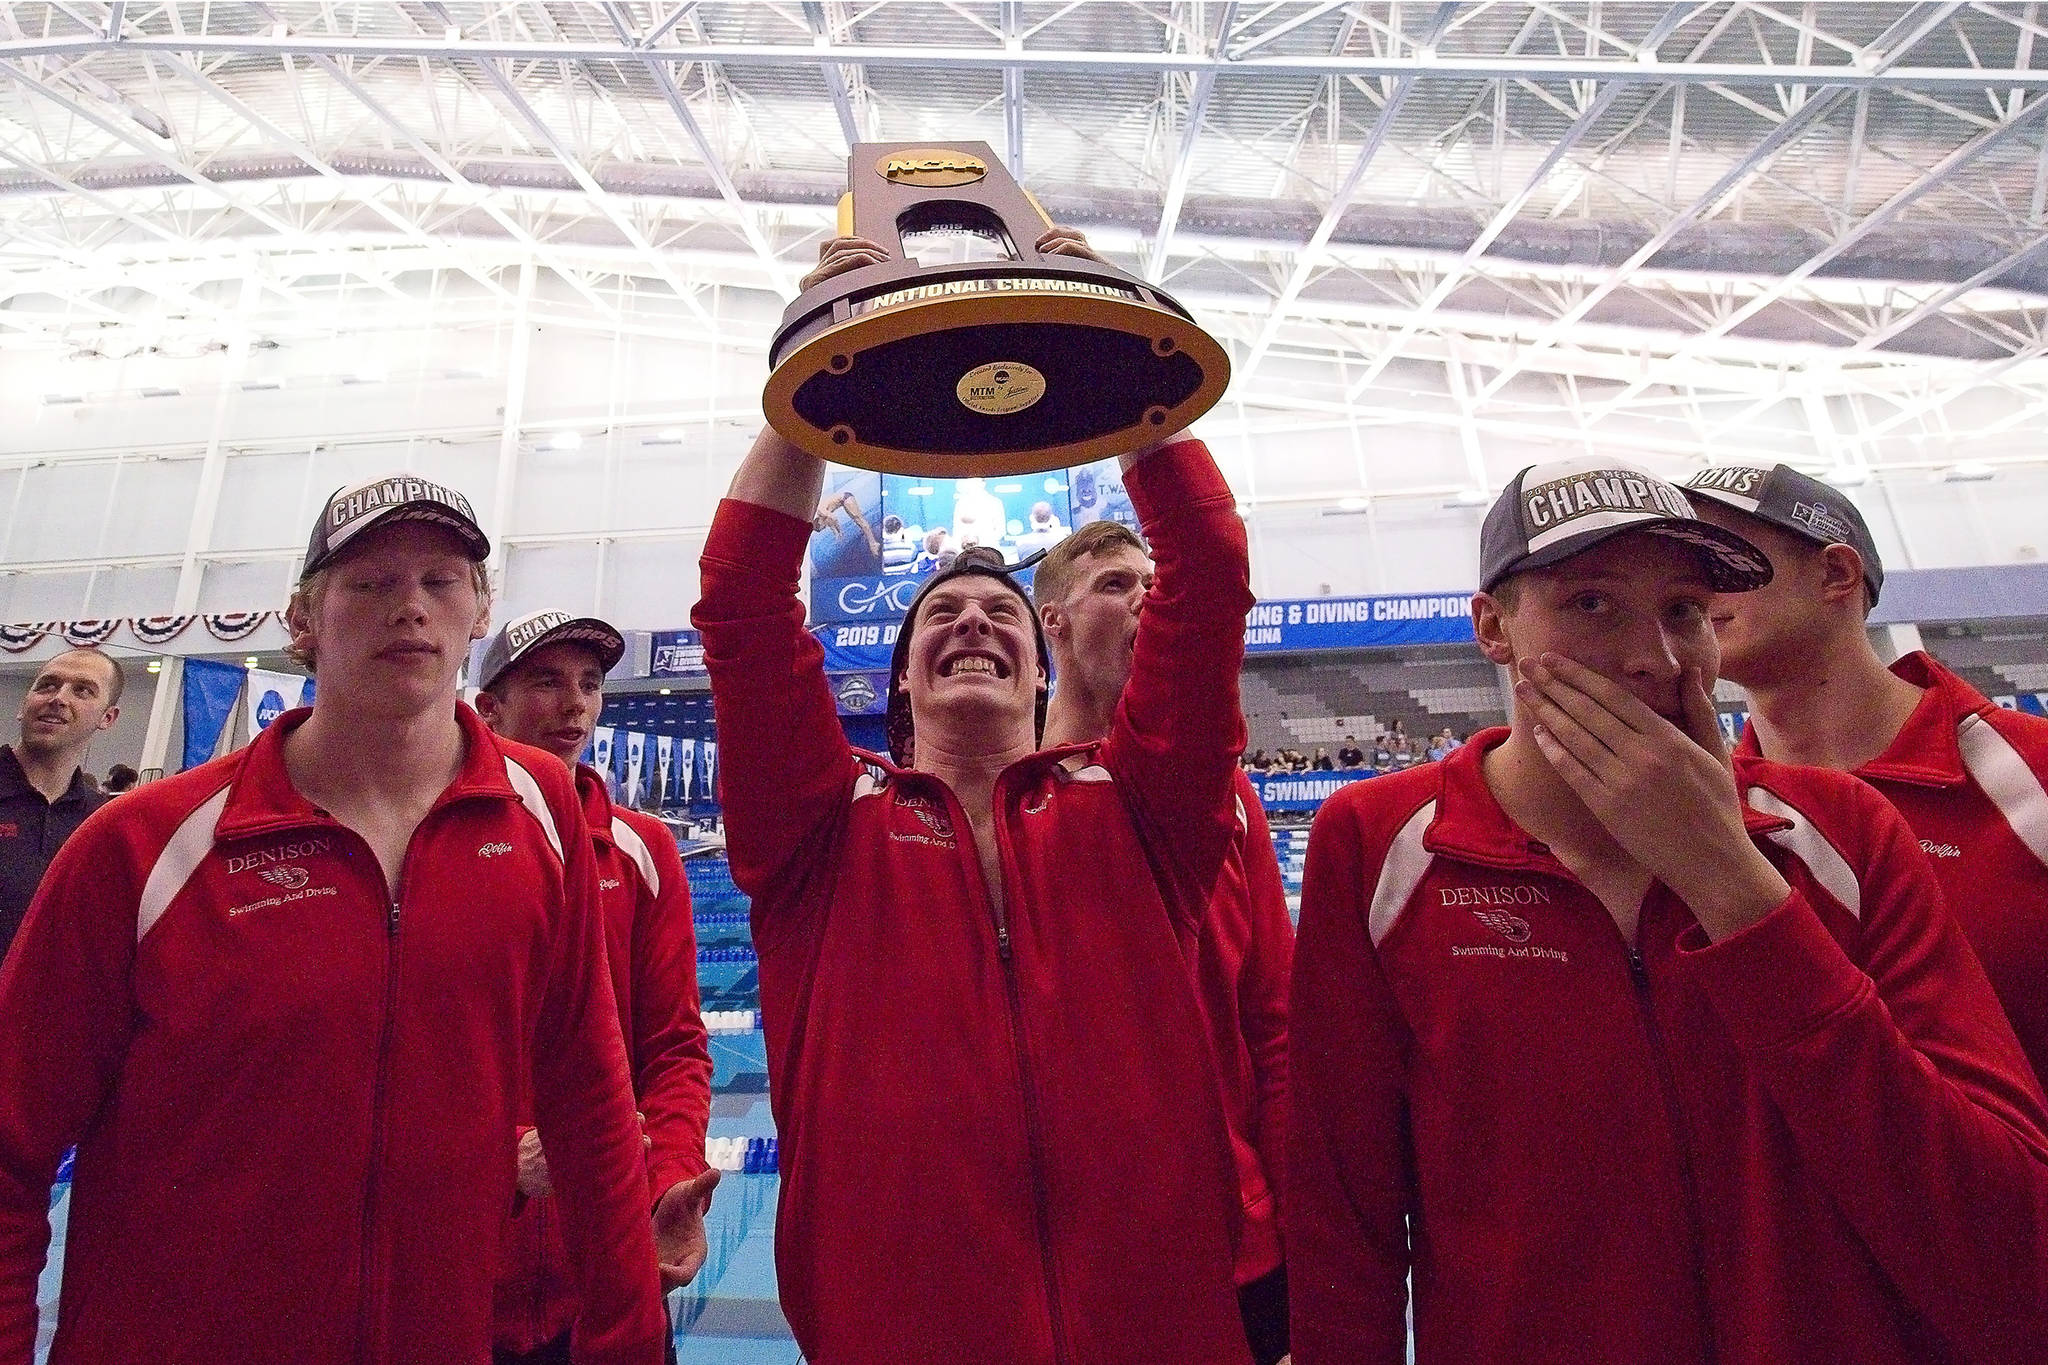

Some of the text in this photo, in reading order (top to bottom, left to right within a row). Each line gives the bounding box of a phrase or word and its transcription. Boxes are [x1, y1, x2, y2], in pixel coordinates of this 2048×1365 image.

[886, 159, 985, 178] NCAA
[873, 280, 991, 310] NATIONAL
[970, 387, 995, 396] MTM
[1560, 472, 1599, 487] NCAA
[1288, 604, 1302, 625] &
[1307, 602, 1369, 624] DIVING
[835, 625, 880, 647] 2019
[1264, 780, 1358, 802] SWIMMI
[228, 838, 330, 874] DENISON
[1918, 839, 1961, 858] Dolfin
[229, 886, 337, 917] Swimming And Diving
[1439, 885, 1550, 906] DENISON
[1451, 943, 1569, 962] Swimming And Diving
